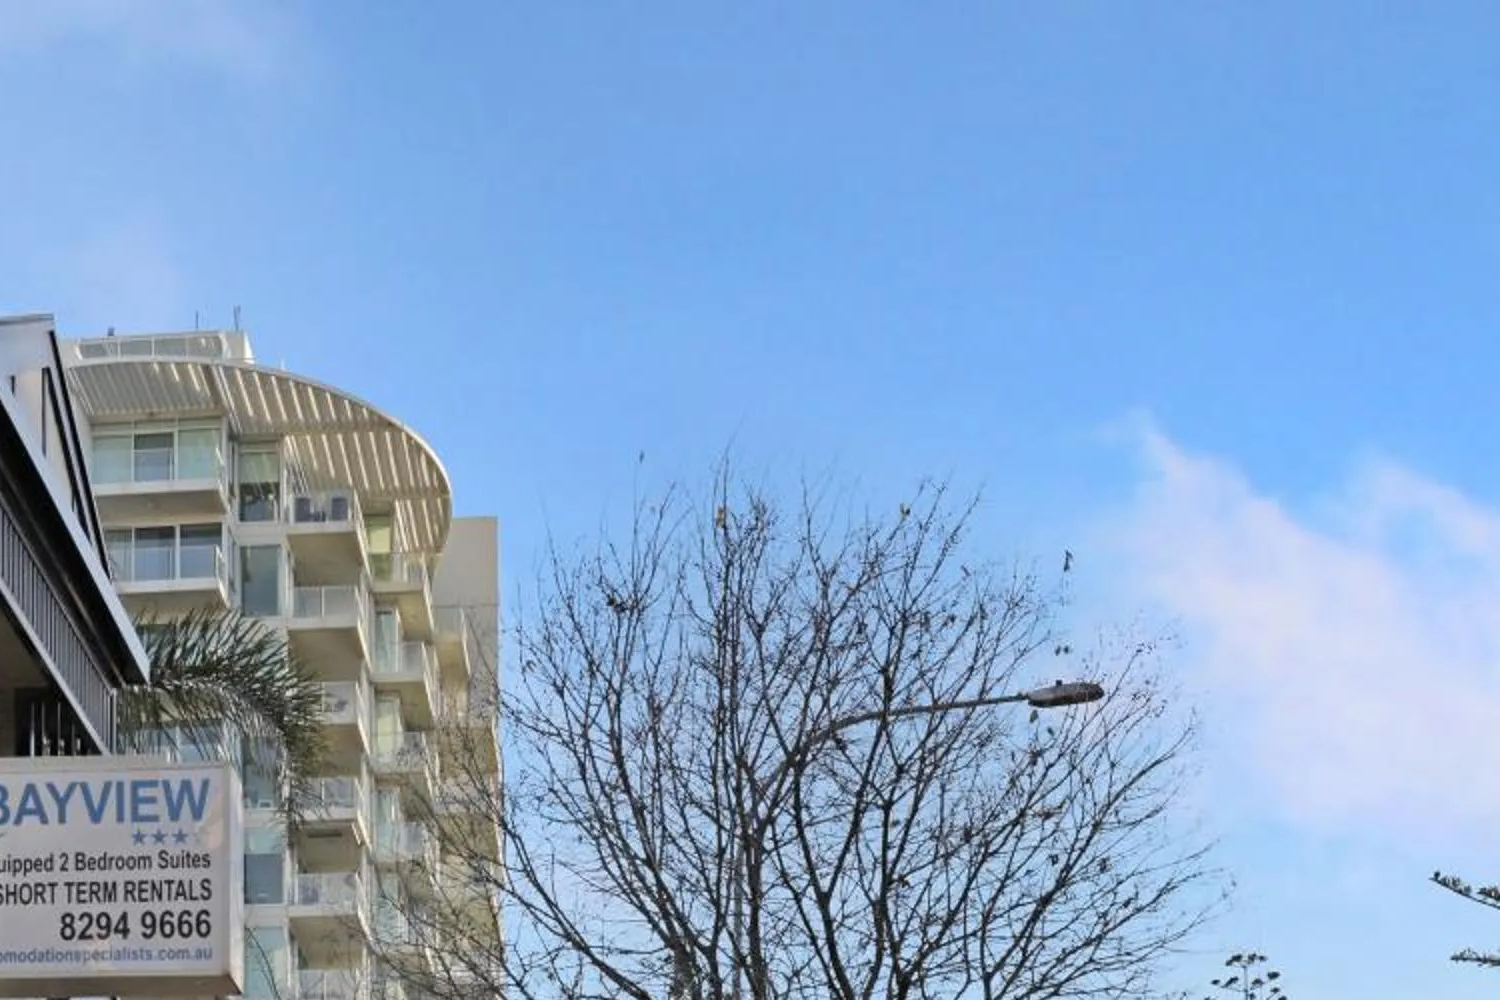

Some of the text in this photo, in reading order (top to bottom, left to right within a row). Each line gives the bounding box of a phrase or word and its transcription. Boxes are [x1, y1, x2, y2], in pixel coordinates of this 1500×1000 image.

[59, 852, 70, 872] 2
[74, 849, 153, 872] Bedroom
[157, 849, 211, 870] Suites
[63, 881, 118, 904] TERM
[123, 878, 212, 902] RENTALS
[59, 909, 212, 941] 8294 9666
